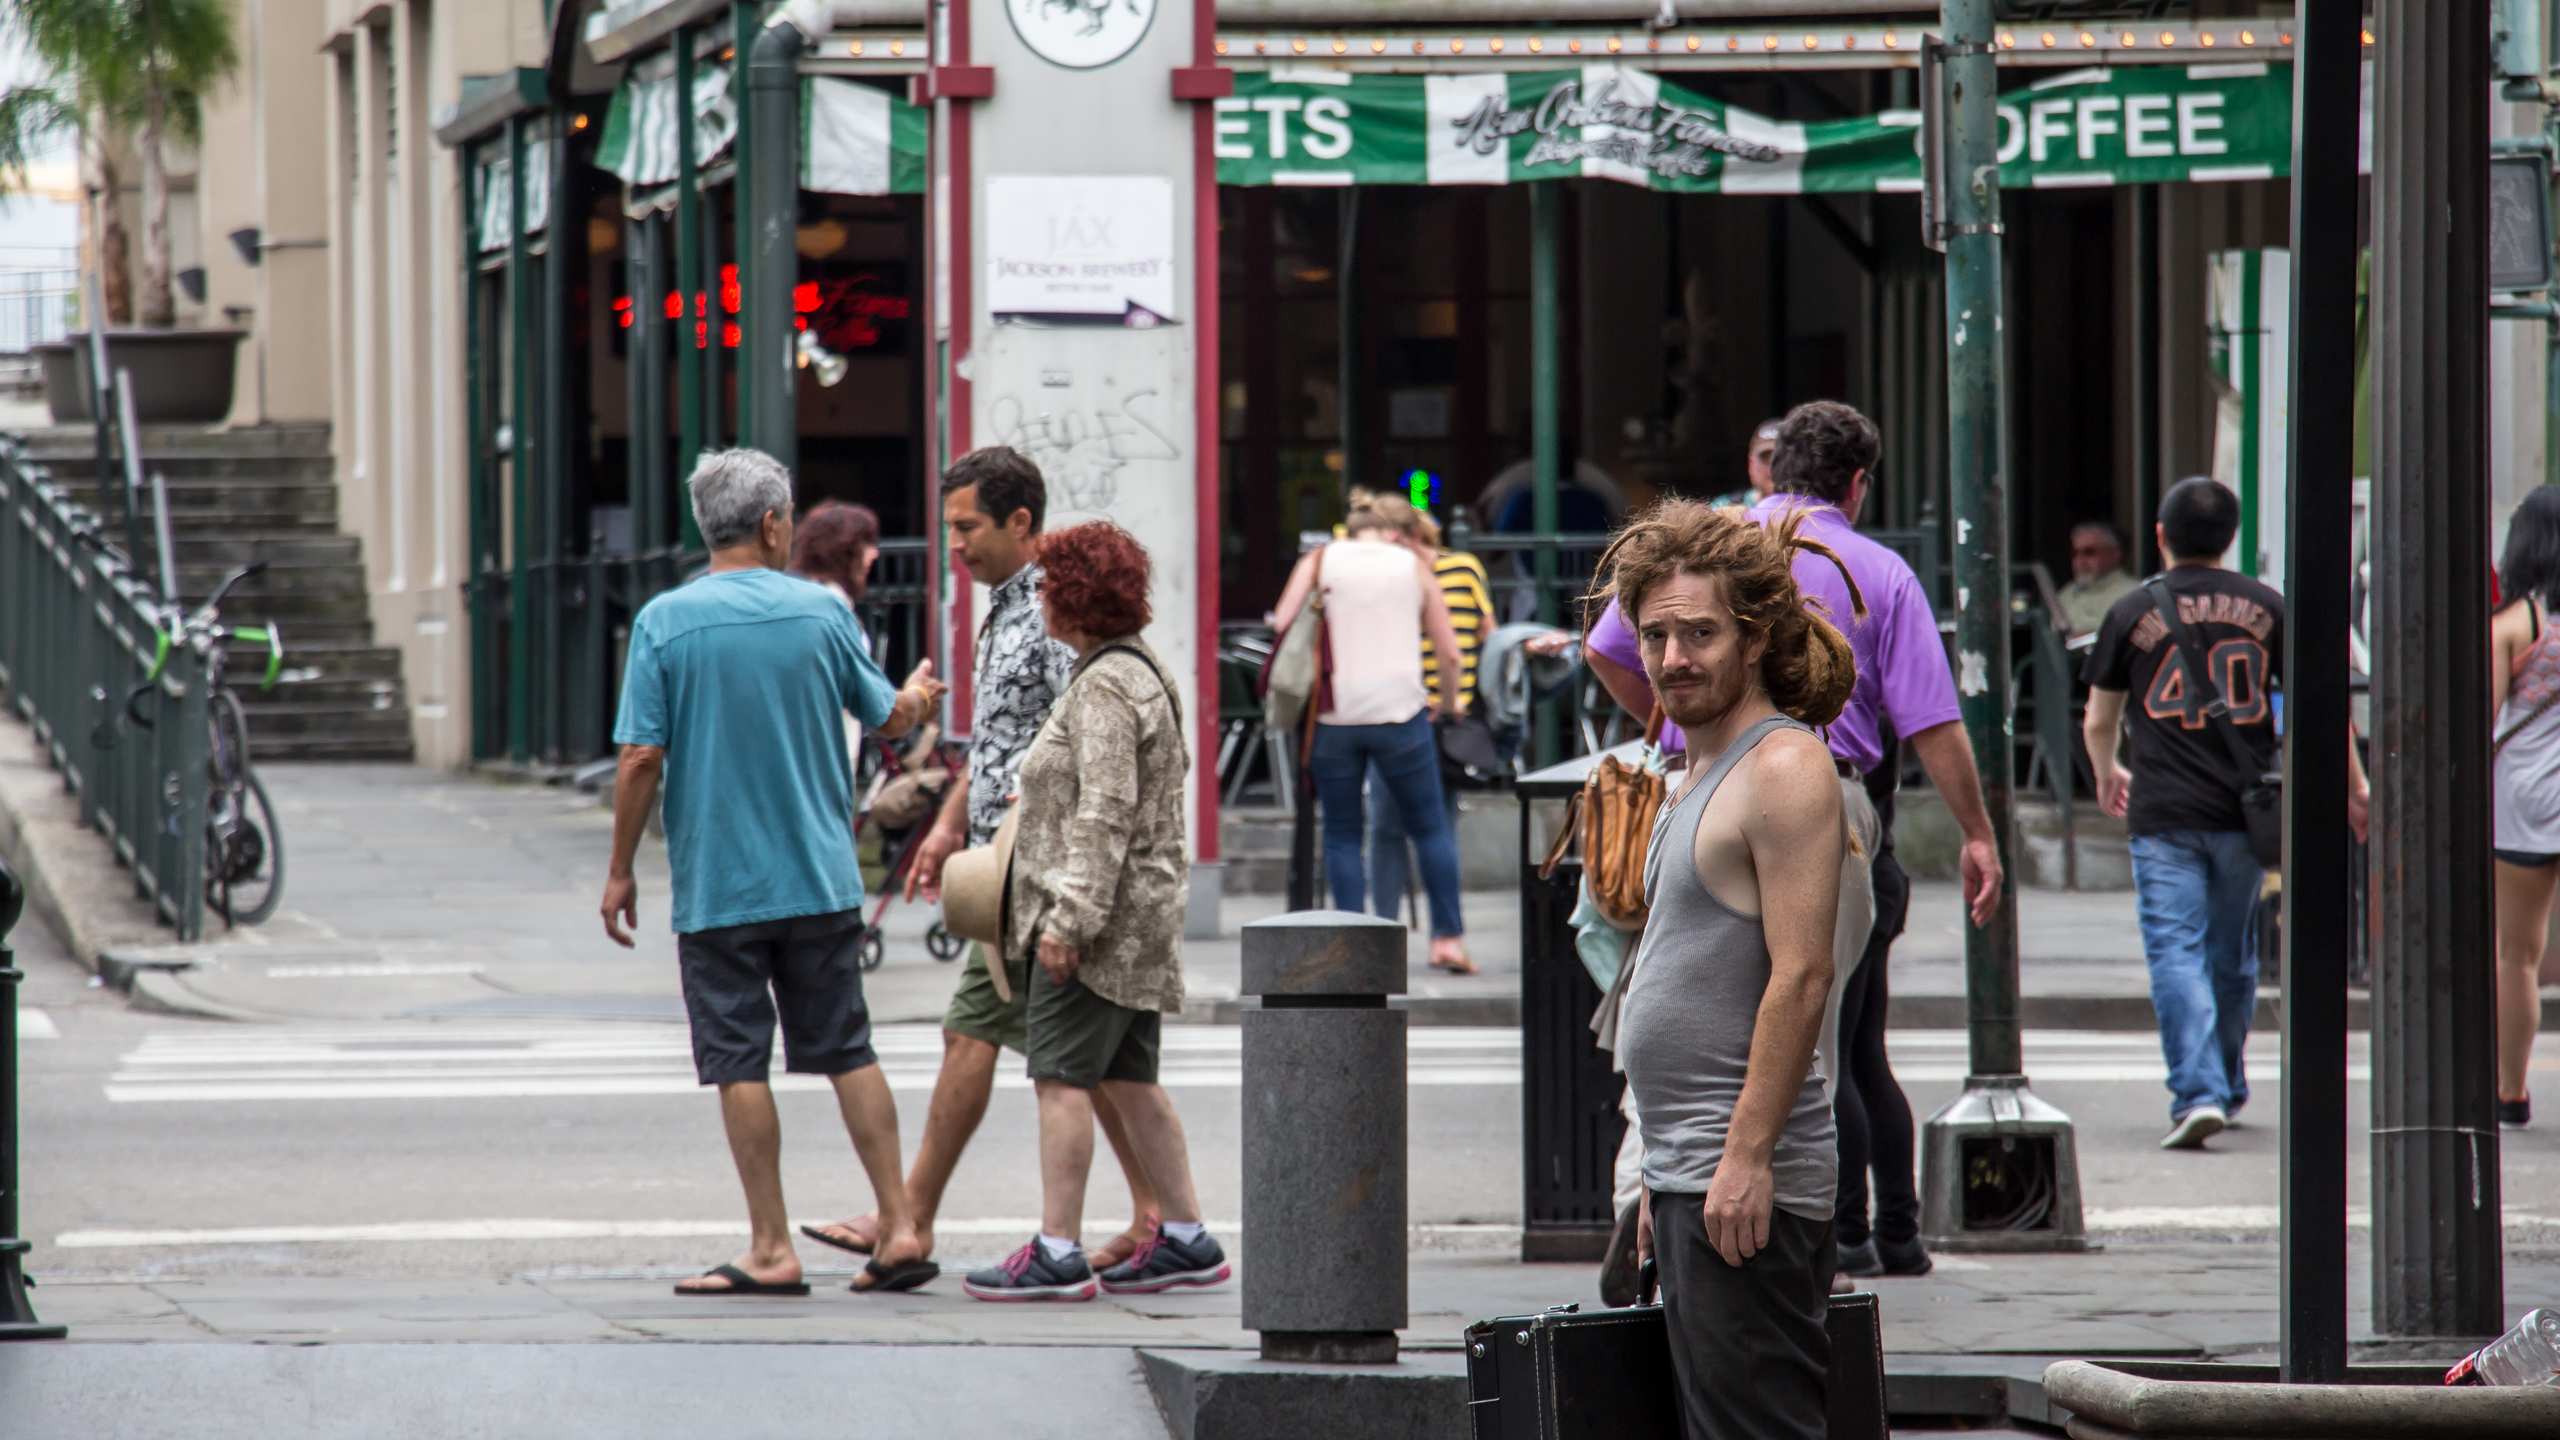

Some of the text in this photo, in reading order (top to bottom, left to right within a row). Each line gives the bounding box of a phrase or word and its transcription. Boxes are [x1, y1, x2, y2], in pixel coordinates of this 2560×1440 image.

[1452, 79, 1782, 162] New Orleans Famous
[1914, 93, 2227, 164] OFFEE
[998, 257, 1163, 281] JACKSON BREWERY
[1044, 215, 1115, 257] JAX
[2144, 637, 2268, 730] 40
